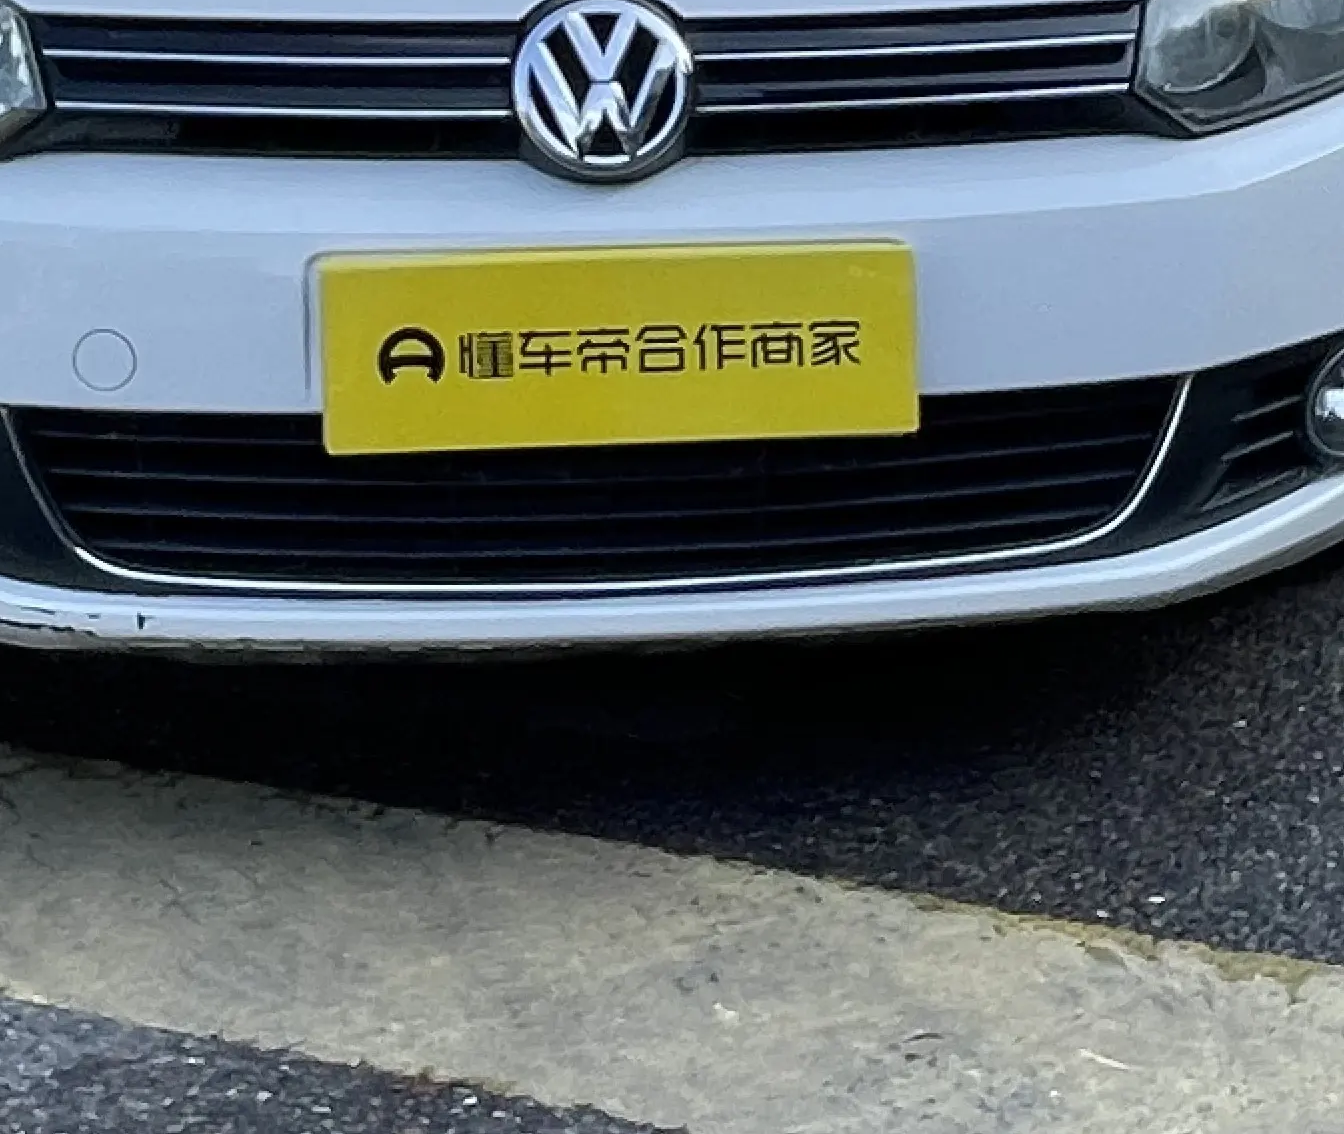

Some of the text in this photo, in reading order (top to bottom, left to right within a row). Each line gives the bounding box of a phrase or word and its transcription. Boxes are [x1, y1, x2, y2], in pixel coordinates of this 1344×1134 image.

[519, 4, 683, 163] VW
[458, 319, 862, 380] 懂车帝合作商家
